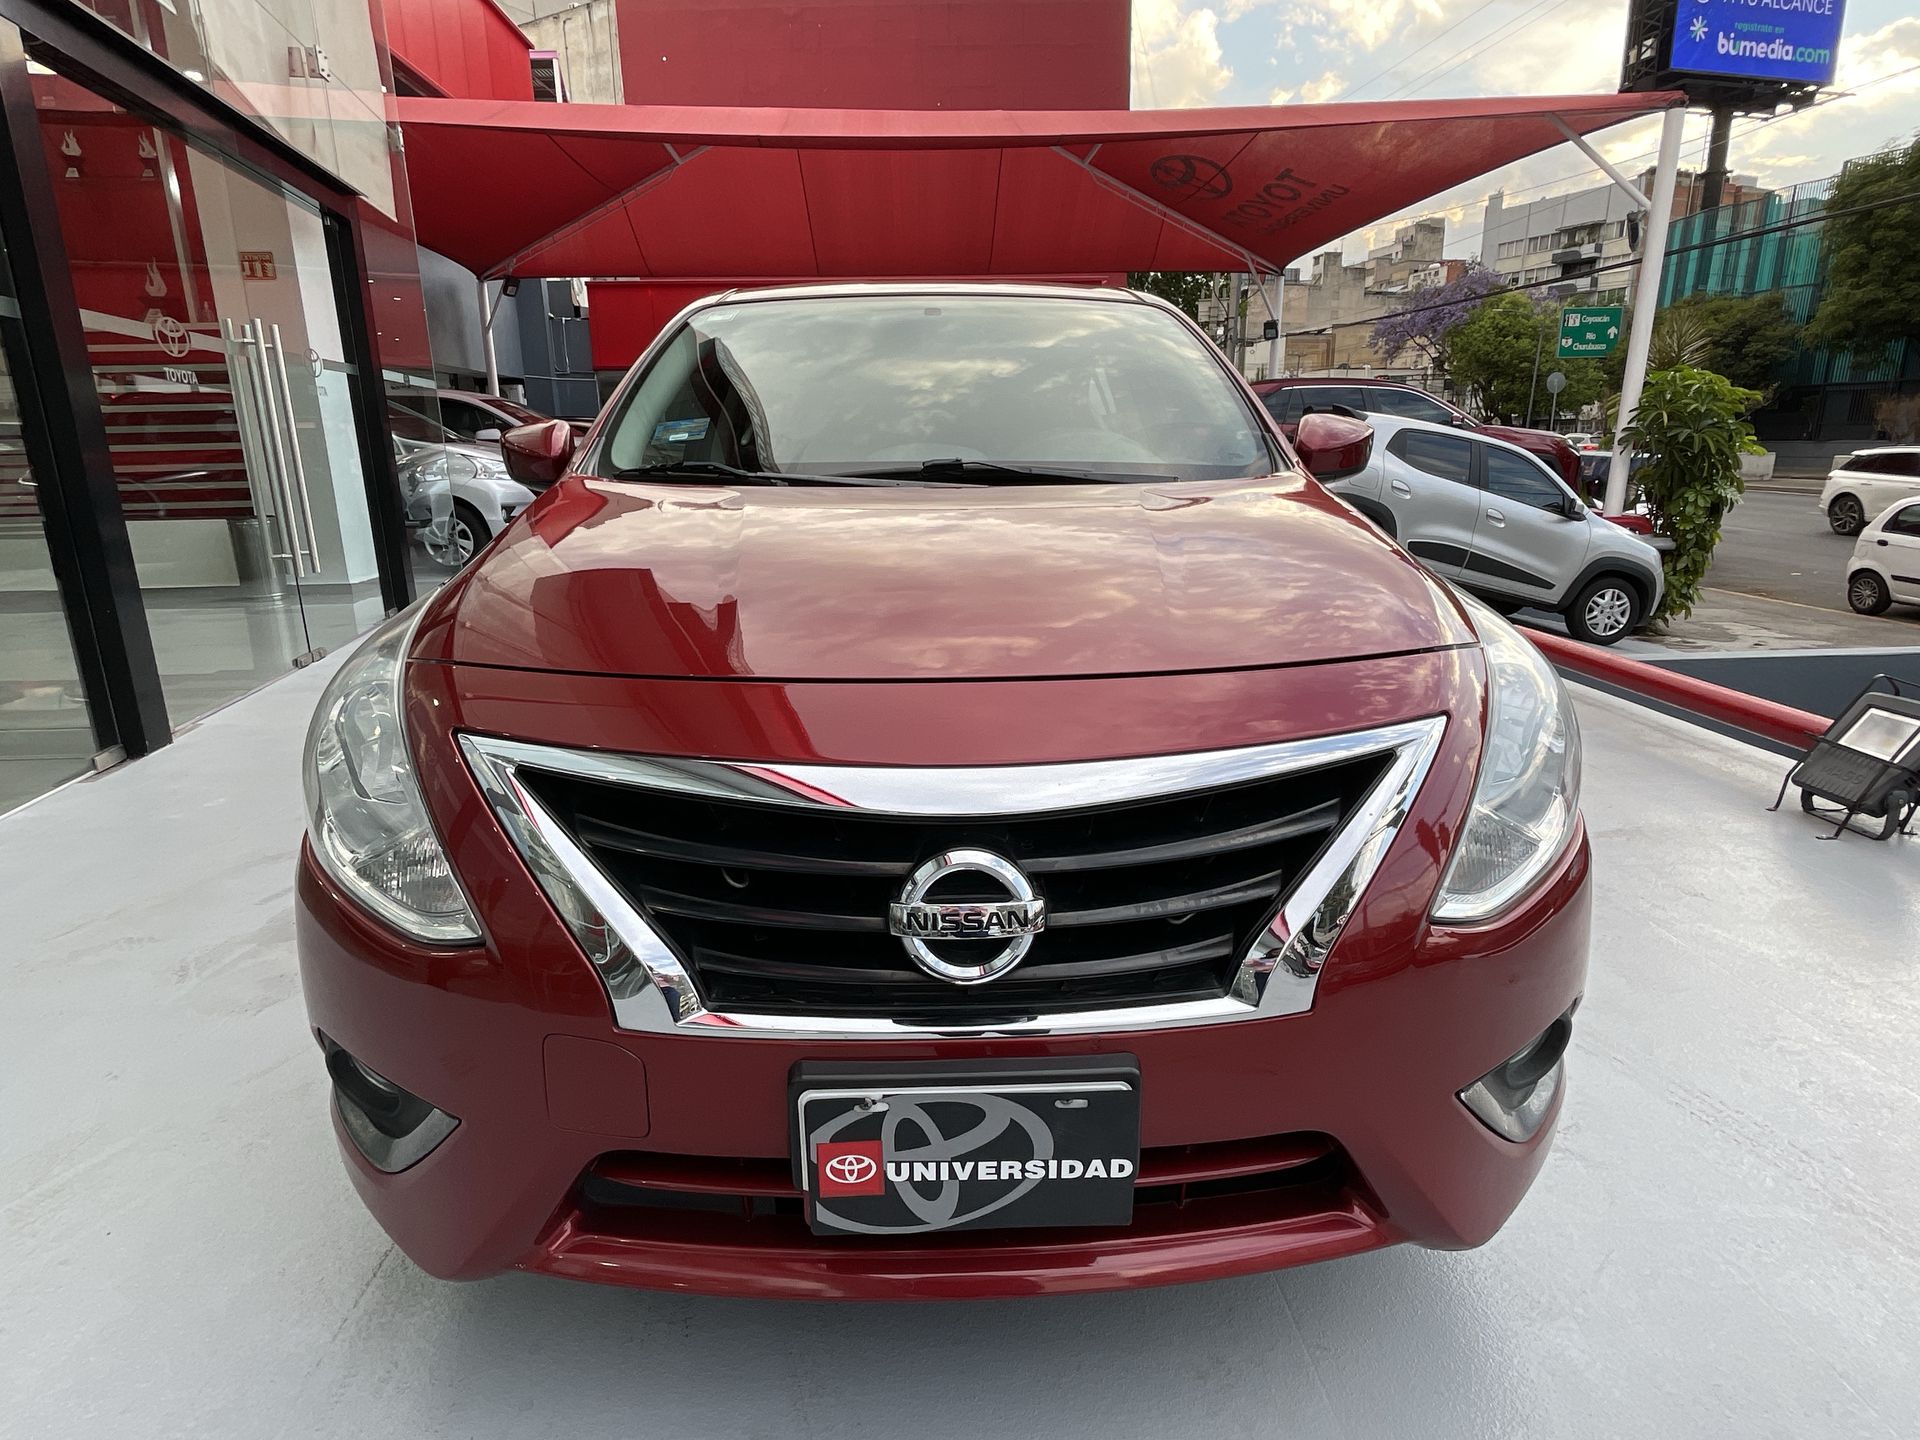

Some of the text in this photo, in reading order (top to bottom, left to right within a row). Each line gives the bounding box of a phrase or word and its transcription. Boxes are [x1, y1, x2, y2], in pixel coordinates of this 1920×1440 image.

[163, 366, 199, 385] TOYOTA
[905, 909, 1029, 933] NISSAN
[886, 1158, 1133, 1182] UNIVERSIDAD
